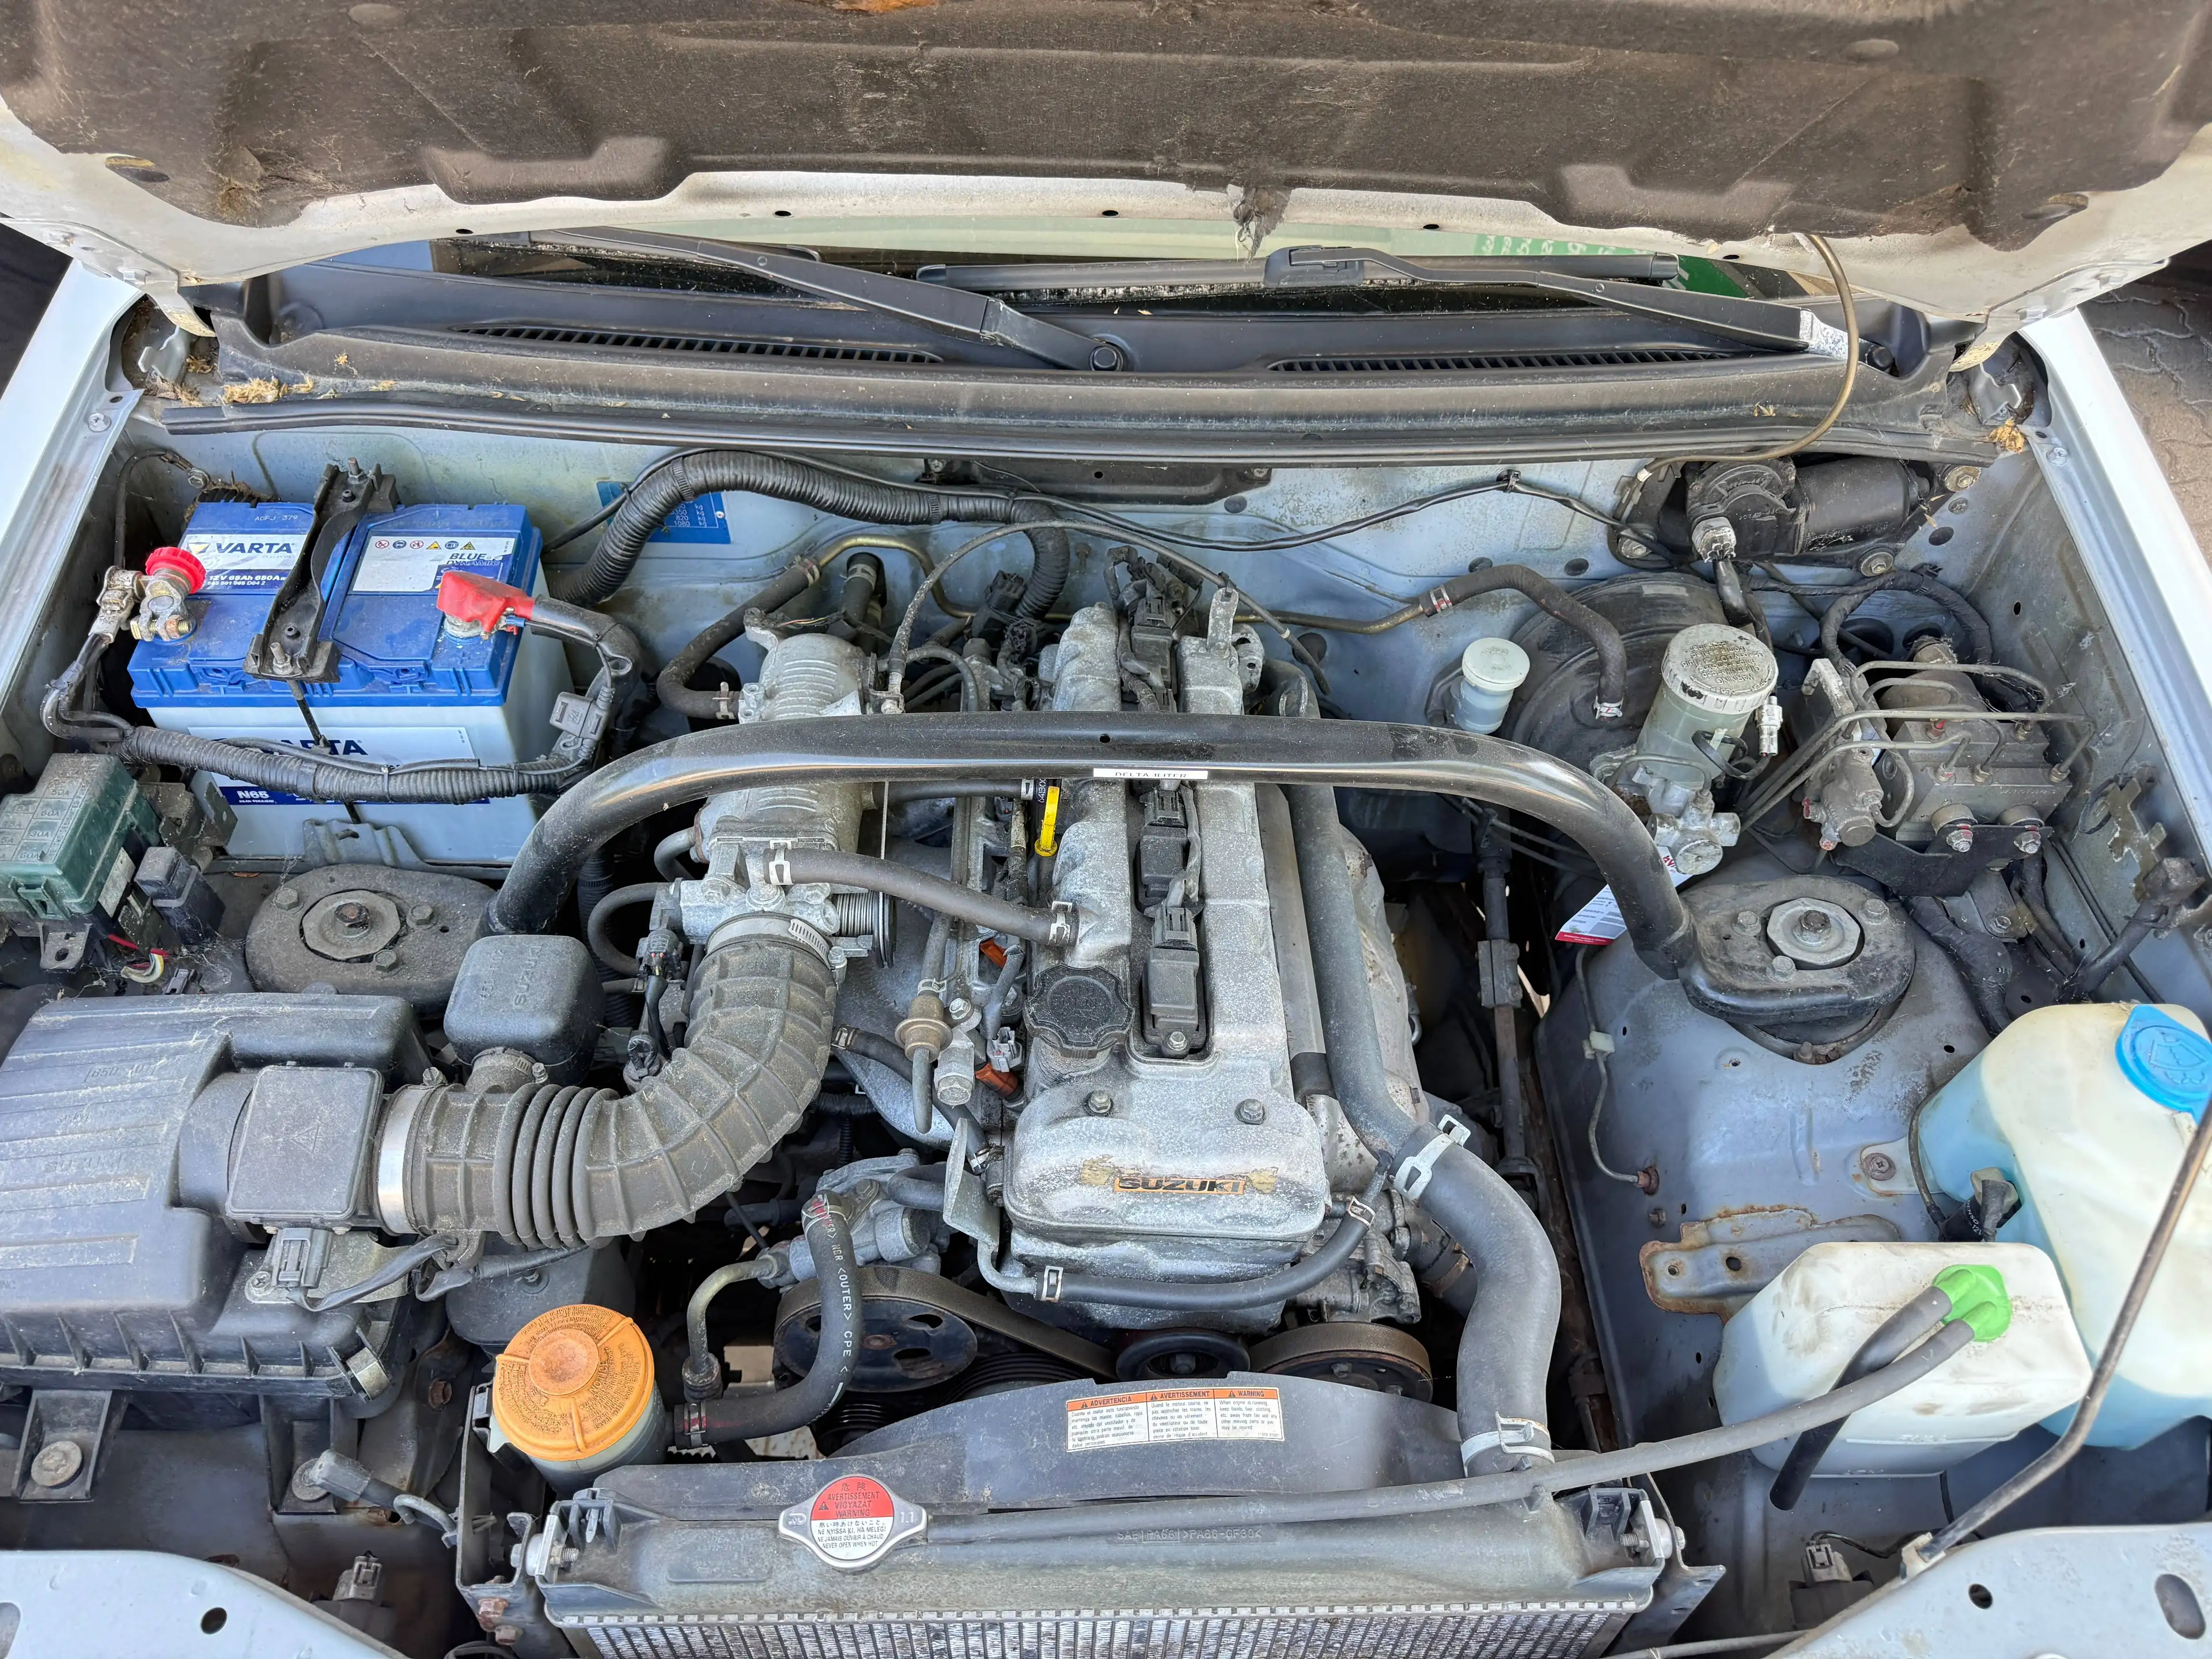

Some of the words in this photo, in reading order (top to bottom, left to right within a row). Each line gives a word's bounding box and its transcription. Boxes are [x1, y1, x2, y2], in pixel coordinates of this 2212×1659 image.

[216, 543, 292, 553] VARTA
[1716, 673, 1755, 684] WARNING
[1710, 685, 1737, 694] CLOSE
[1751, 679, 1768, 691] OPEN
[237, 791, 269, 799] N65
[1119, 1176, 1240, 1192] SUZUKI
[843, 1331, 853, 1357] CPE
[588, 1361, 607, 1394] NOTICE
[1090, 1396, 1131, 1406] ADVERTENCIA
[827, 1492, 880, 1501] AVERTISSEMENT
[835, 1509, 870, 1517] WARNING
[901, 1512, 914, 1523] 1.1
